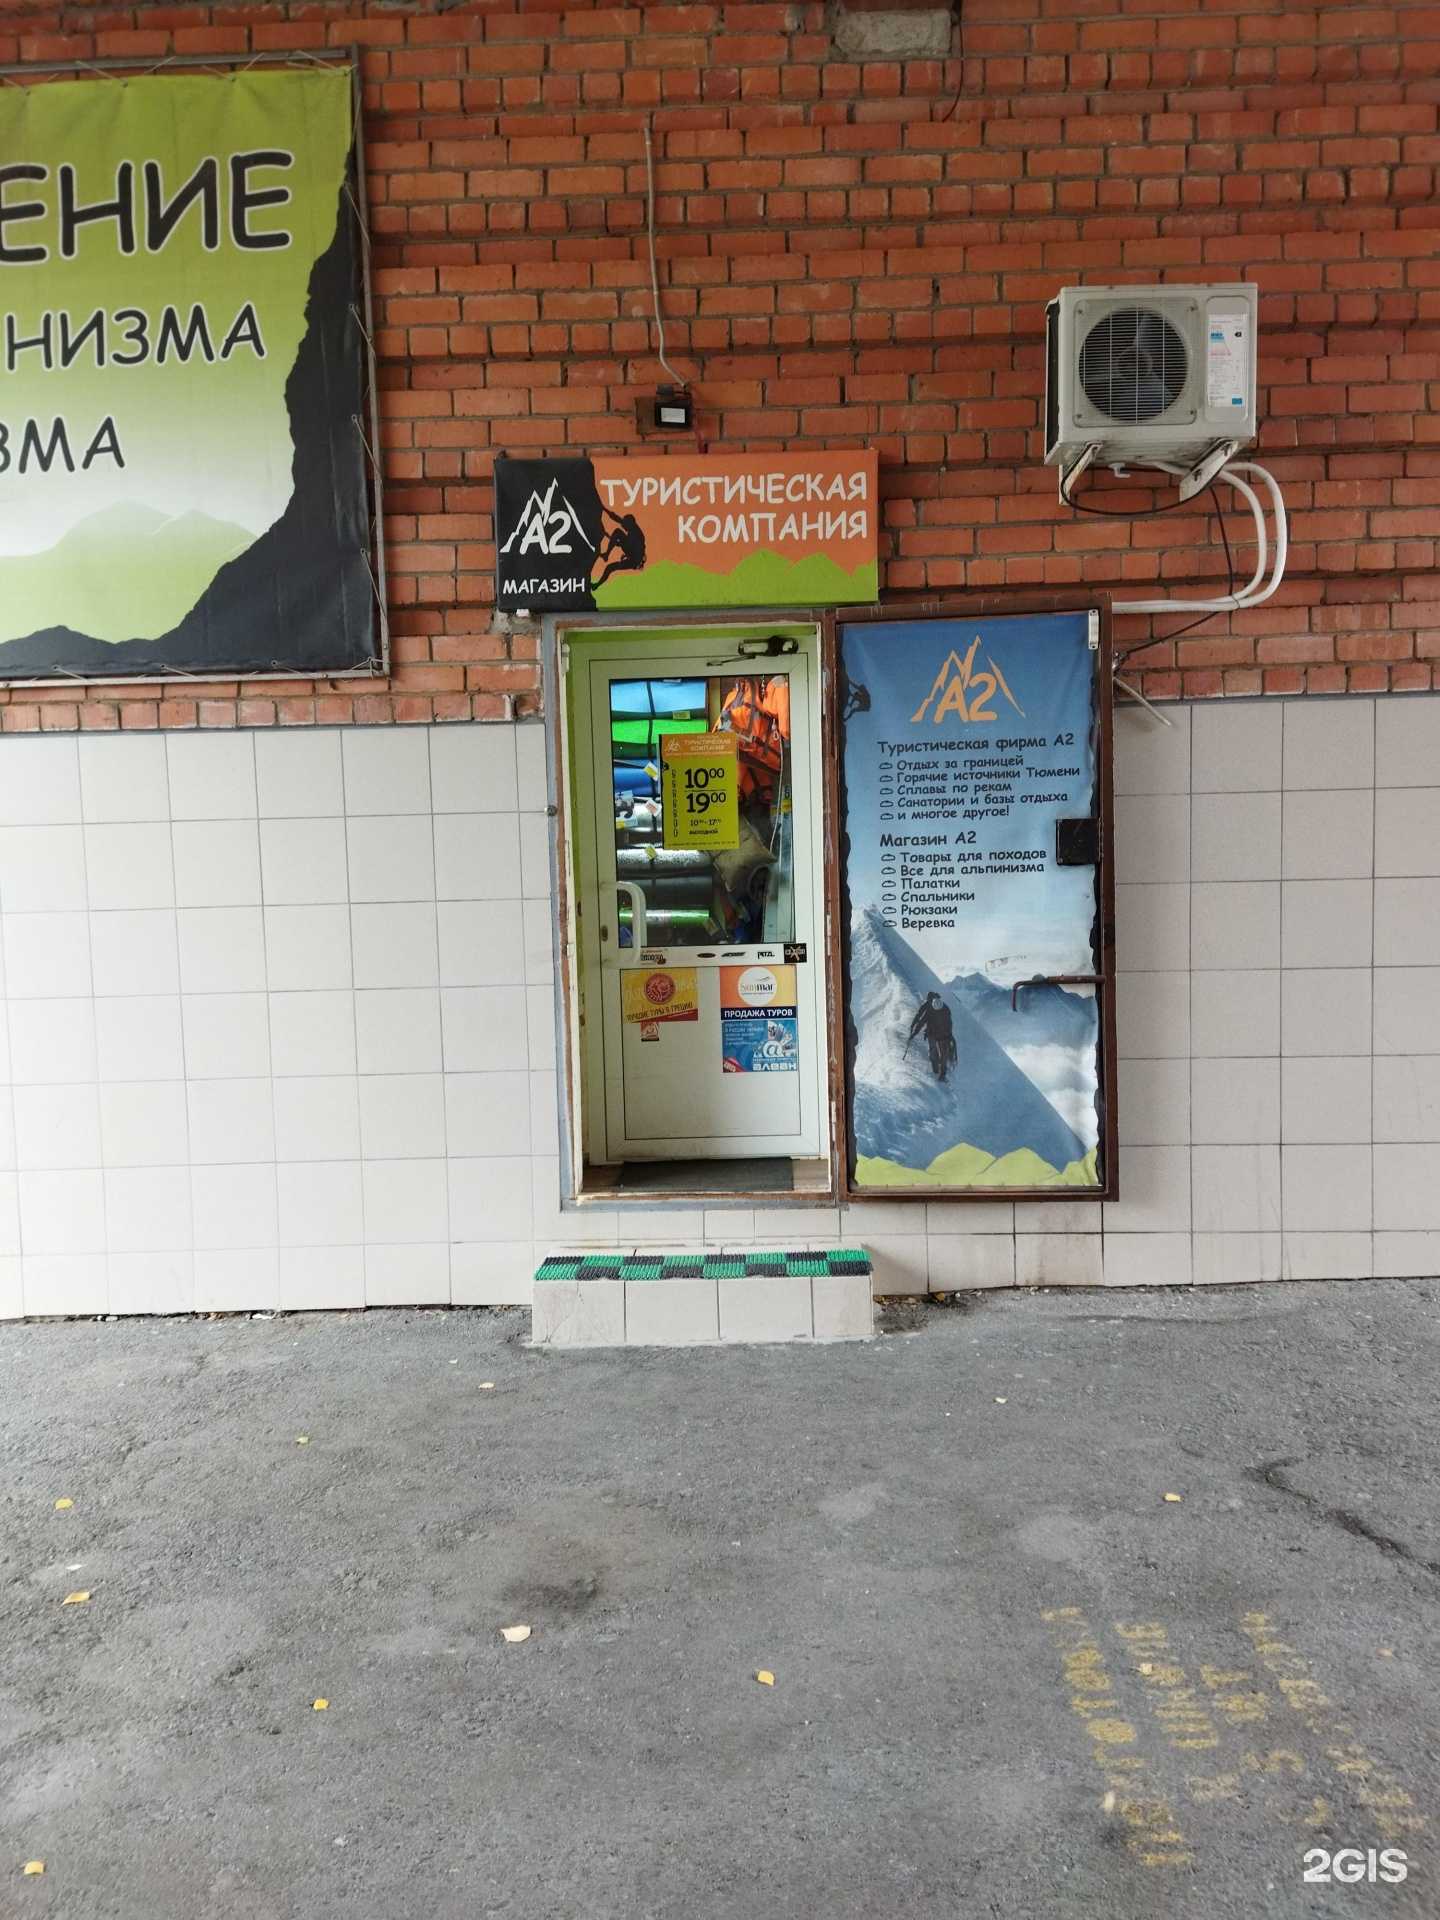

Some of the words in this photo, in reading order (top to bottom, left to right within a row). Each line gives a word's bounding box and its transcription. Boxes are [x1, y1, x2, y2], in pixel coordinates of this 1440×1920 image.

[0, 416, 126, 474] МА
[600, 471, 867, 507] ТУРИСТИЧЕСКАЯ
[677, 510, 868, 544] КОМПАНИЯ
[502, 577, 585, 595] МАГАЗИН
[877, 740, 989, 757] Туристическая
[996, 735, 1047, 752] фирма
[1054, 733, 1075, 746] А2
[897, 760, 939, 771] Отдых
[945, 760, 958, 769] за
[964, 755, 1024, 769] границей
[897, 772, 948, 784] Горячие
[954, 770, 1021, 781] источники
[1026, 767, 1080, 778] Тюмени
[897, 784, 946, 795] Сплавы
[953, 784, 968, 793] по
[974, 782, 1012, 794] рекам
[897, 796, 964, 809] Санатории
[970, 797, 979, 805] и
[984, 793, 1014, 805] базы
[1020, 792, 1068, 804] отдыха
[898, 812, 906, 820] и
[911, 809, 957, 820] многое
[963, 806, 1009, 820] другое!
[880, 834, 947, 847] Магазин
[955, 831, 977, 844] А2
[900, 852, 951, 865] Товары
[957, 852, 982, 862] для
[989, 849, 1047, 861] походов
[900, 865, 924, 876] Все
[930, 866, 955, 877] для
[961, 862, 1045, 875] альпинизма
[901, 878, 960, 889] Палатки
[901, 891, 975, 902] Спальники
[901, 904, 958, 915] Рюкзаки
[902, 917, 955, 931] Веревка
[724, 1009, 766, 1018] ПРОДАЖА
[767, 1008, 793, 1017] ТУРОВ
